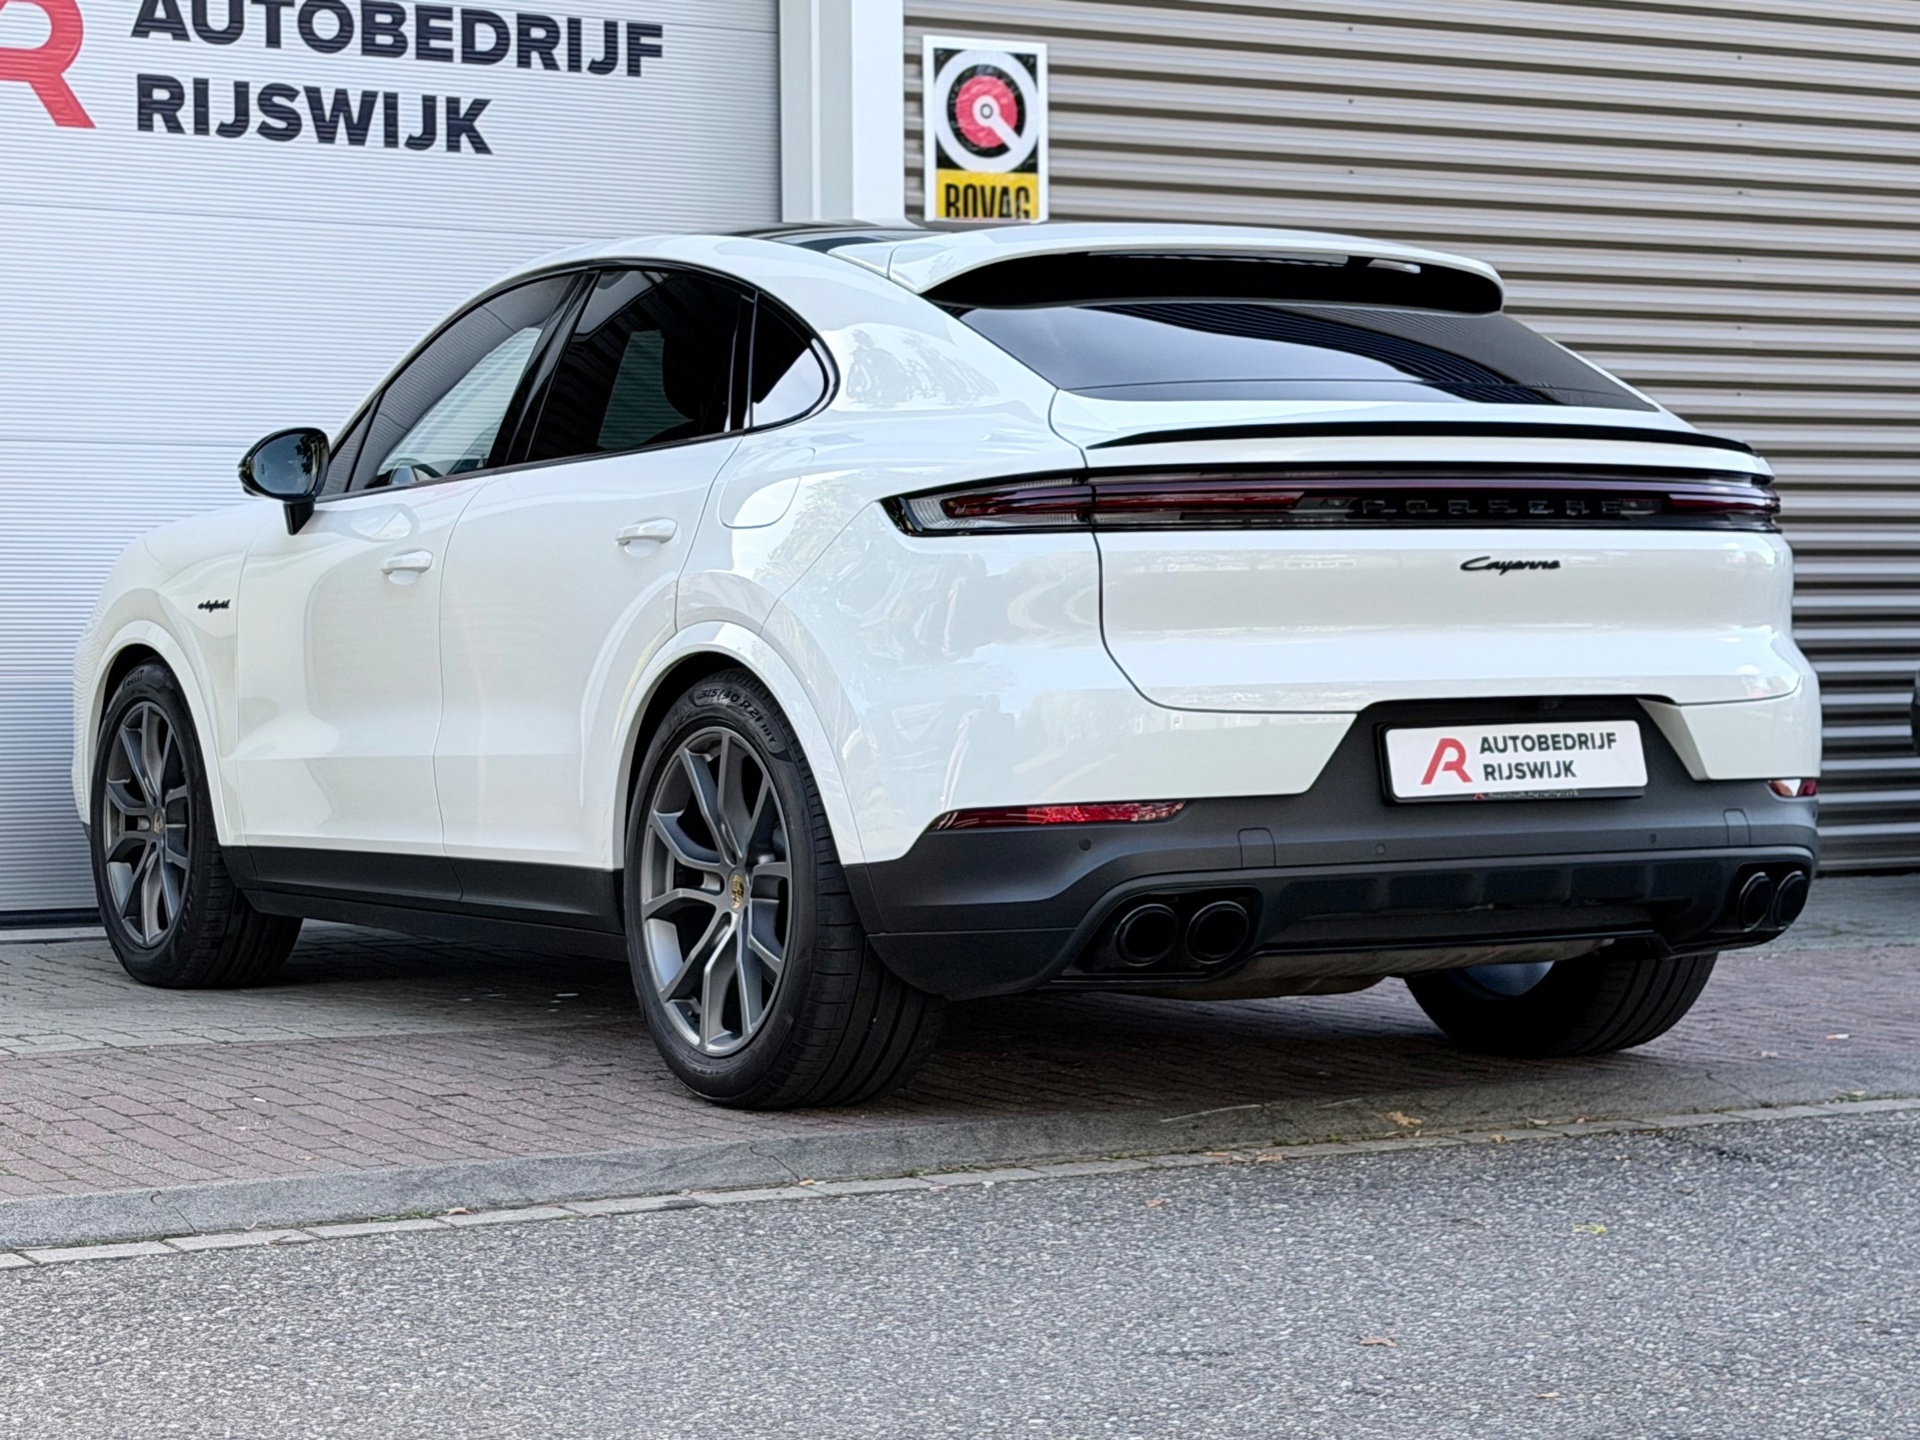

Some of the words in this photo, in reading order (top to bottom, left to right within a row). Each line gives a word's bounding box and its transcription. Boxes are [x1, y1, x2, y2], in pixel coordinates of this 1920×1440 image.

[131, 0, 664, 77] AUTOBEDRIJF
[136, 73, 494, 155] RIJSWIJK
[1459, 555, 1561, 576] Cayenne
[1479, 732, 1617, 755] AUTOBEDRIJF
[1483, 760, 1577, 782] RIJSWIJK
